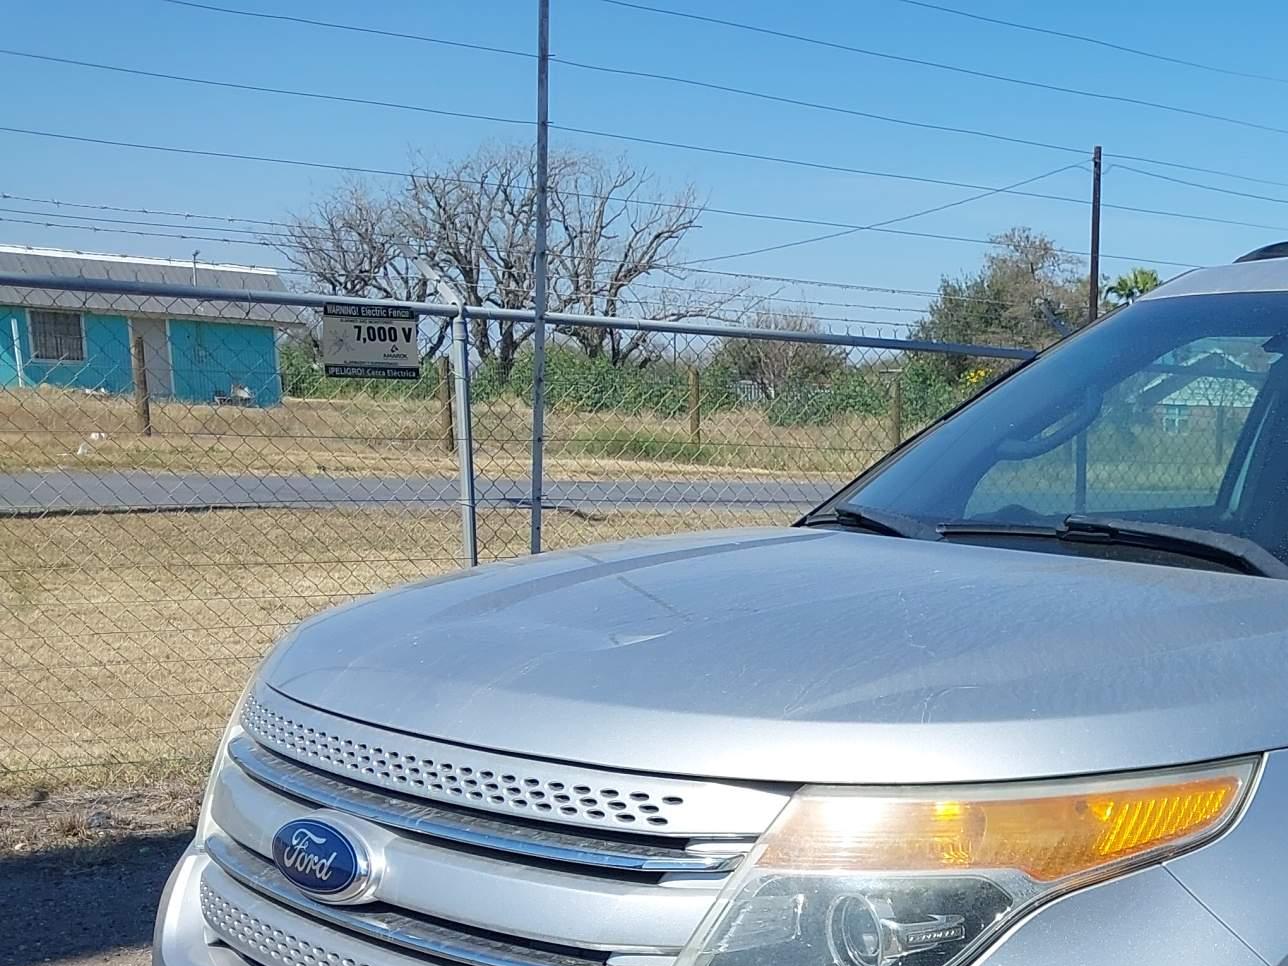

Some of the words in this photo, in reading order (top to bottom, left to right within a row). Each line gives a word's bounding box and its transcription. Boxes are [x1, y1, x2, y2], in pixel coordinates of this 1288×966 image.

[326, 304, 359, 316] WARNING!
[361, 306, 387, 317] Electric
[353, 325, 398, 344] 7,000
[402, 327, 412, 343] V
[283, 828, 338, 881] Ford
